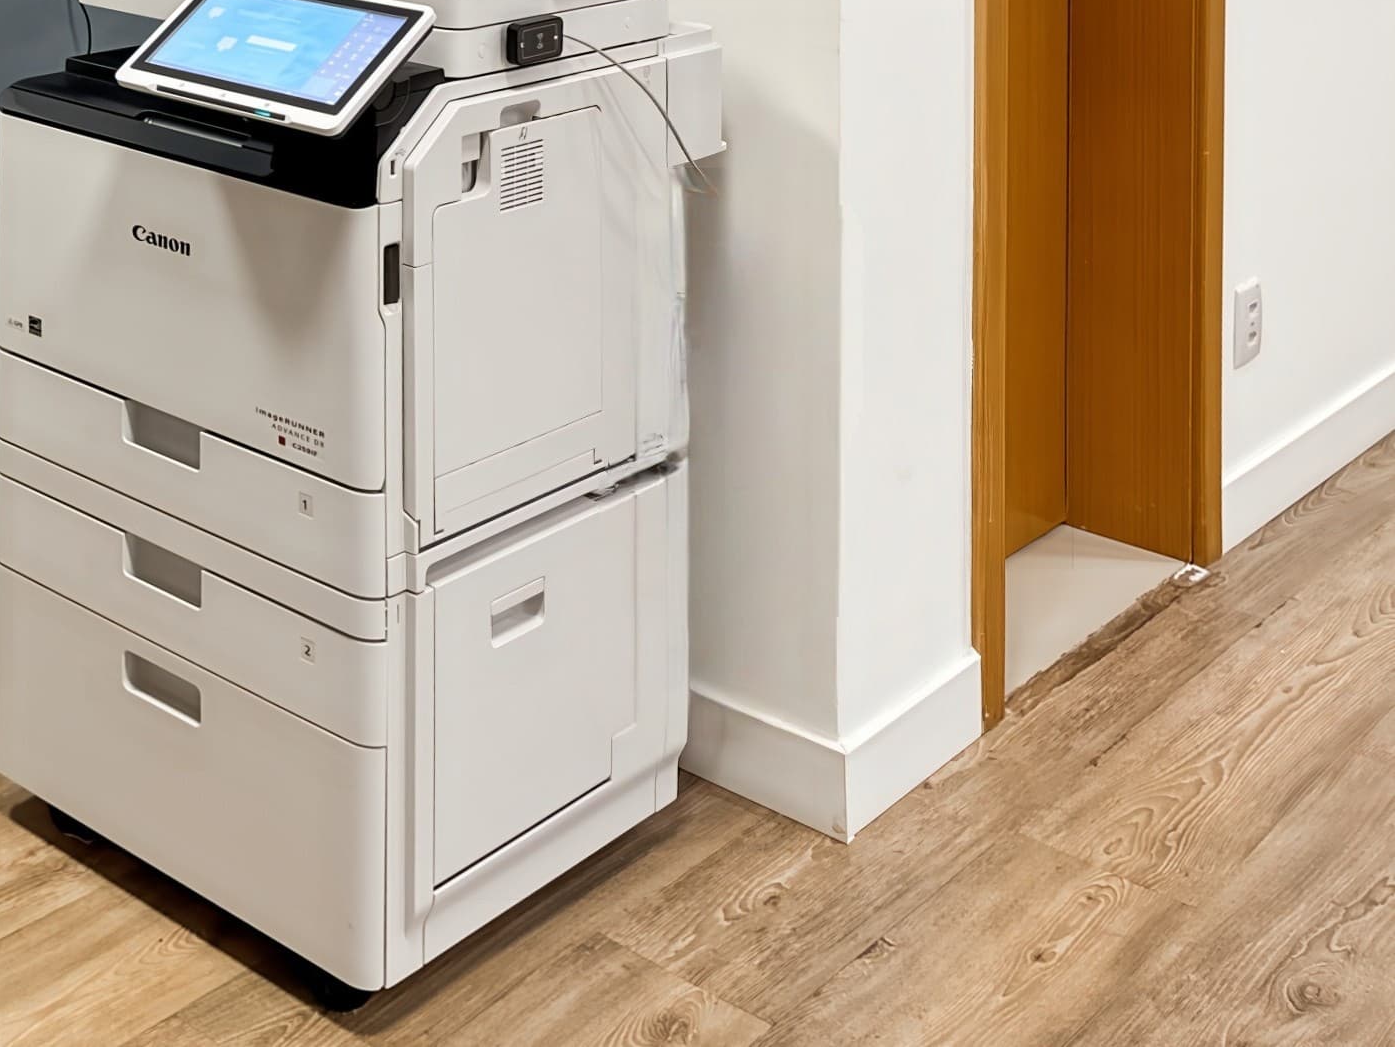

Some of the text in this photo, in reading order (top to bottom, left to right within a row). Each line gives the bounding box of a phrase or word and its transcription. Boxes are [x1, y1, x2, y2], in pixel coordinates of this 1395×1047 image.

[132, 224, 191, 256] Canon
[271, 423, 310, 443] ADVANCE
[304, 644, 312, 657] 2
